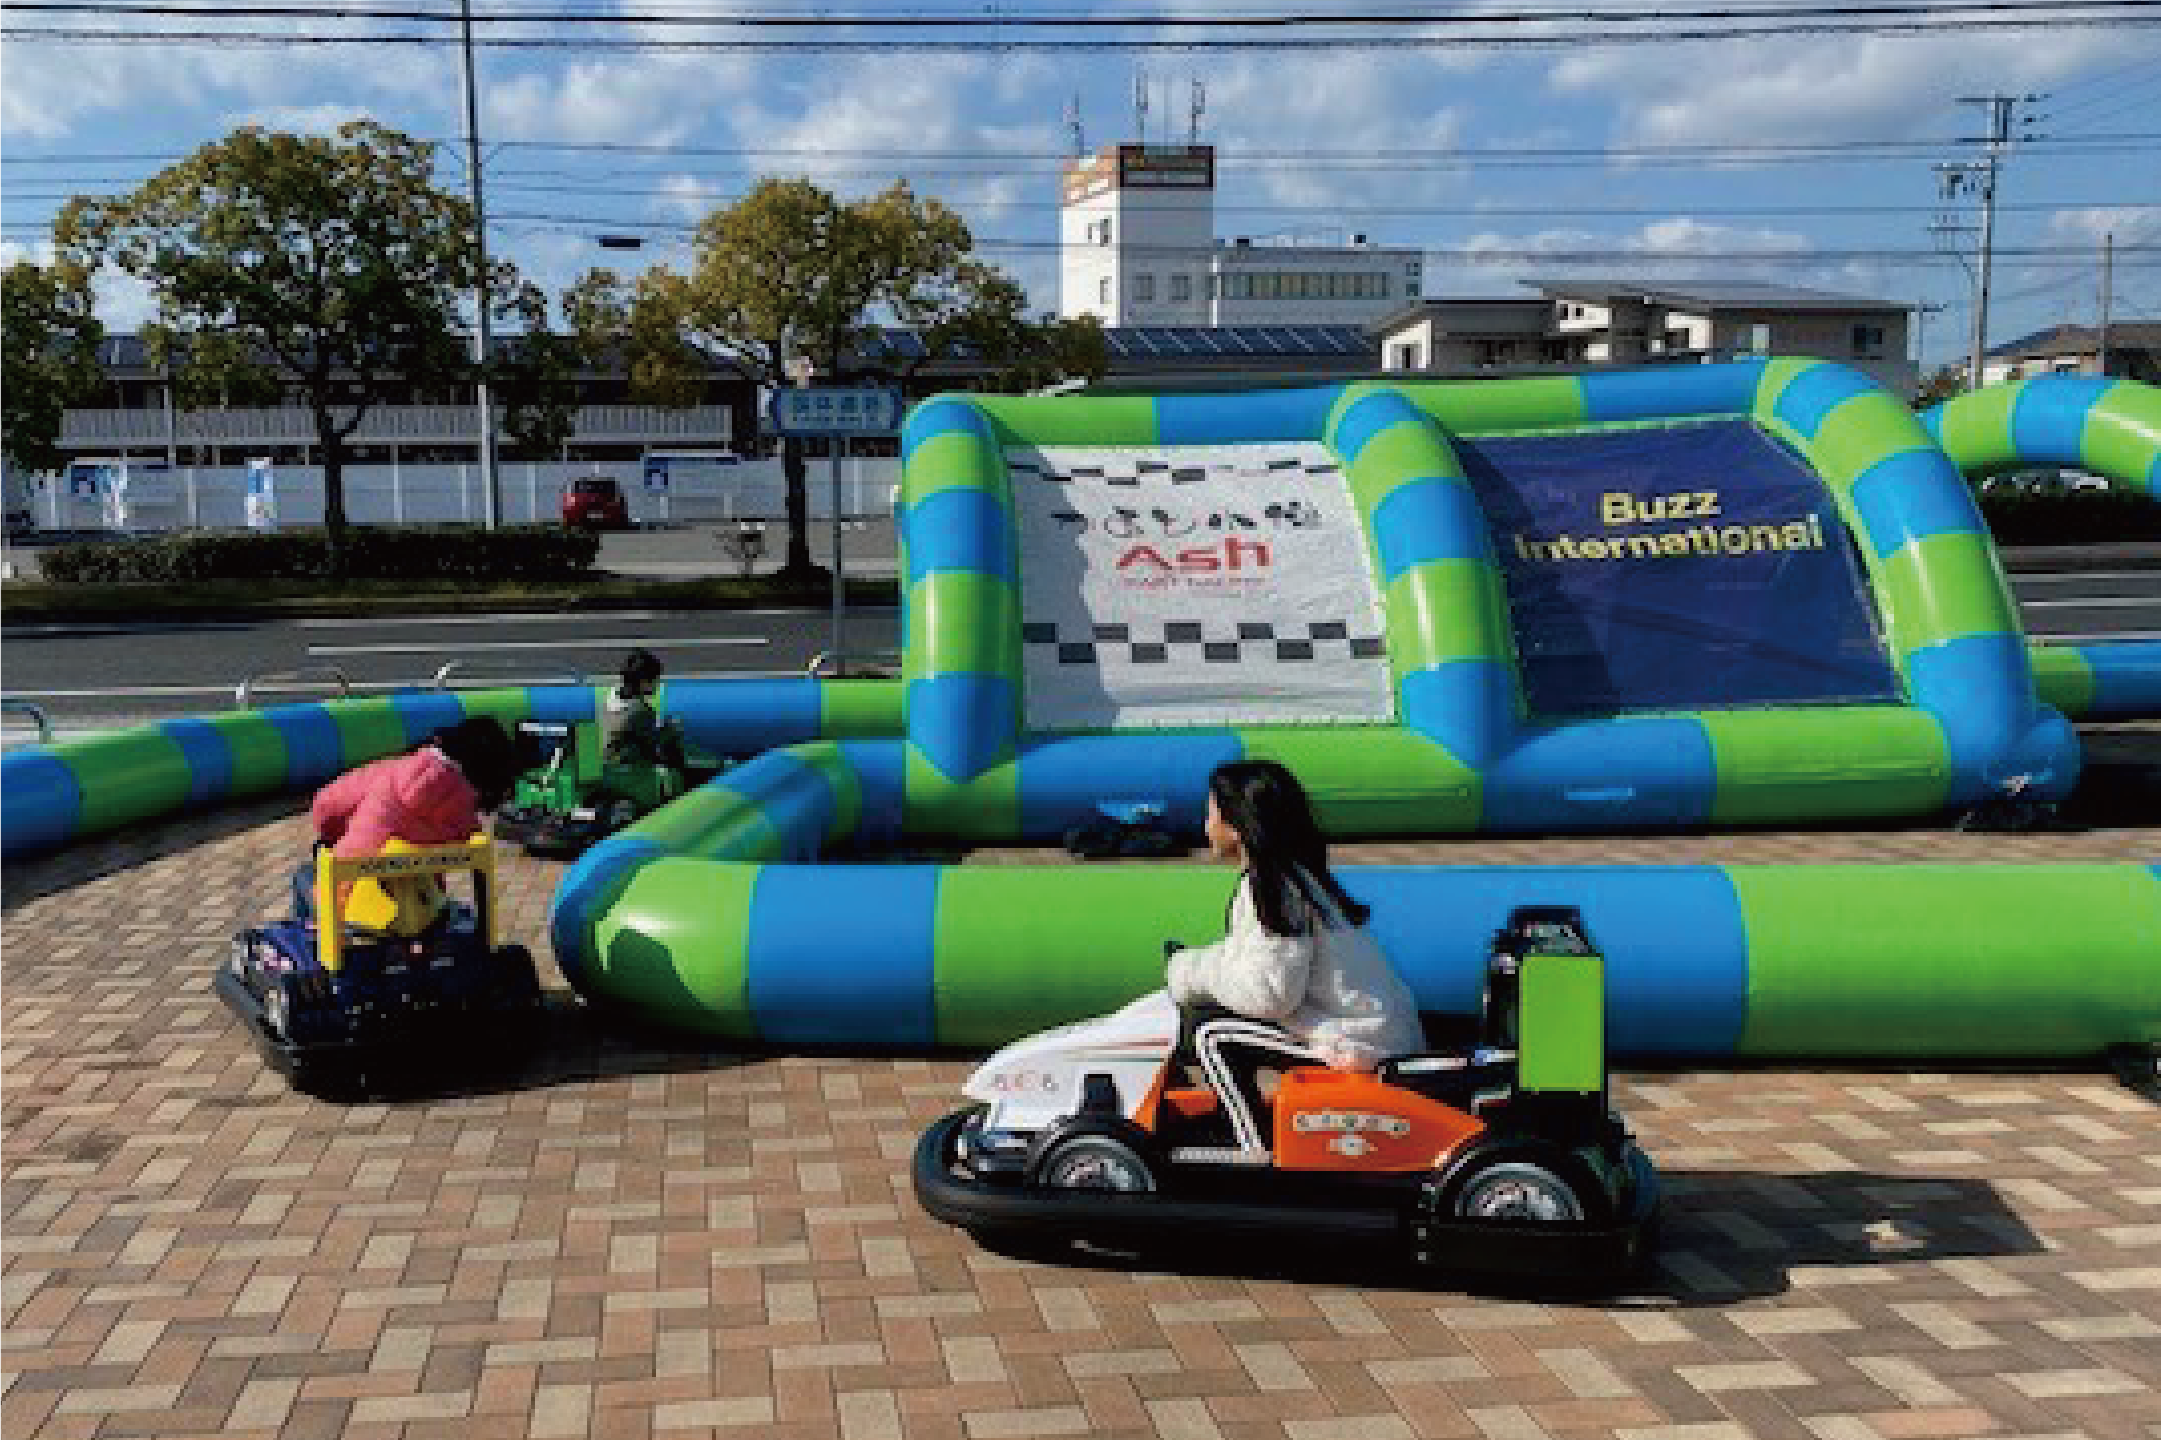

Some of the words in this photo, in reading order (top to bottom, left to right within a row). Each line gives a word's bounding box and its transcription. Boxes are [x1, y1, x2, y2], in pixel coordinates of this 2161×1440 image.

[1602, 492, 1719, 525] Buzz
[1115, 536, 1271, 572] Ash
[1515, 513, 1823, 559] International
